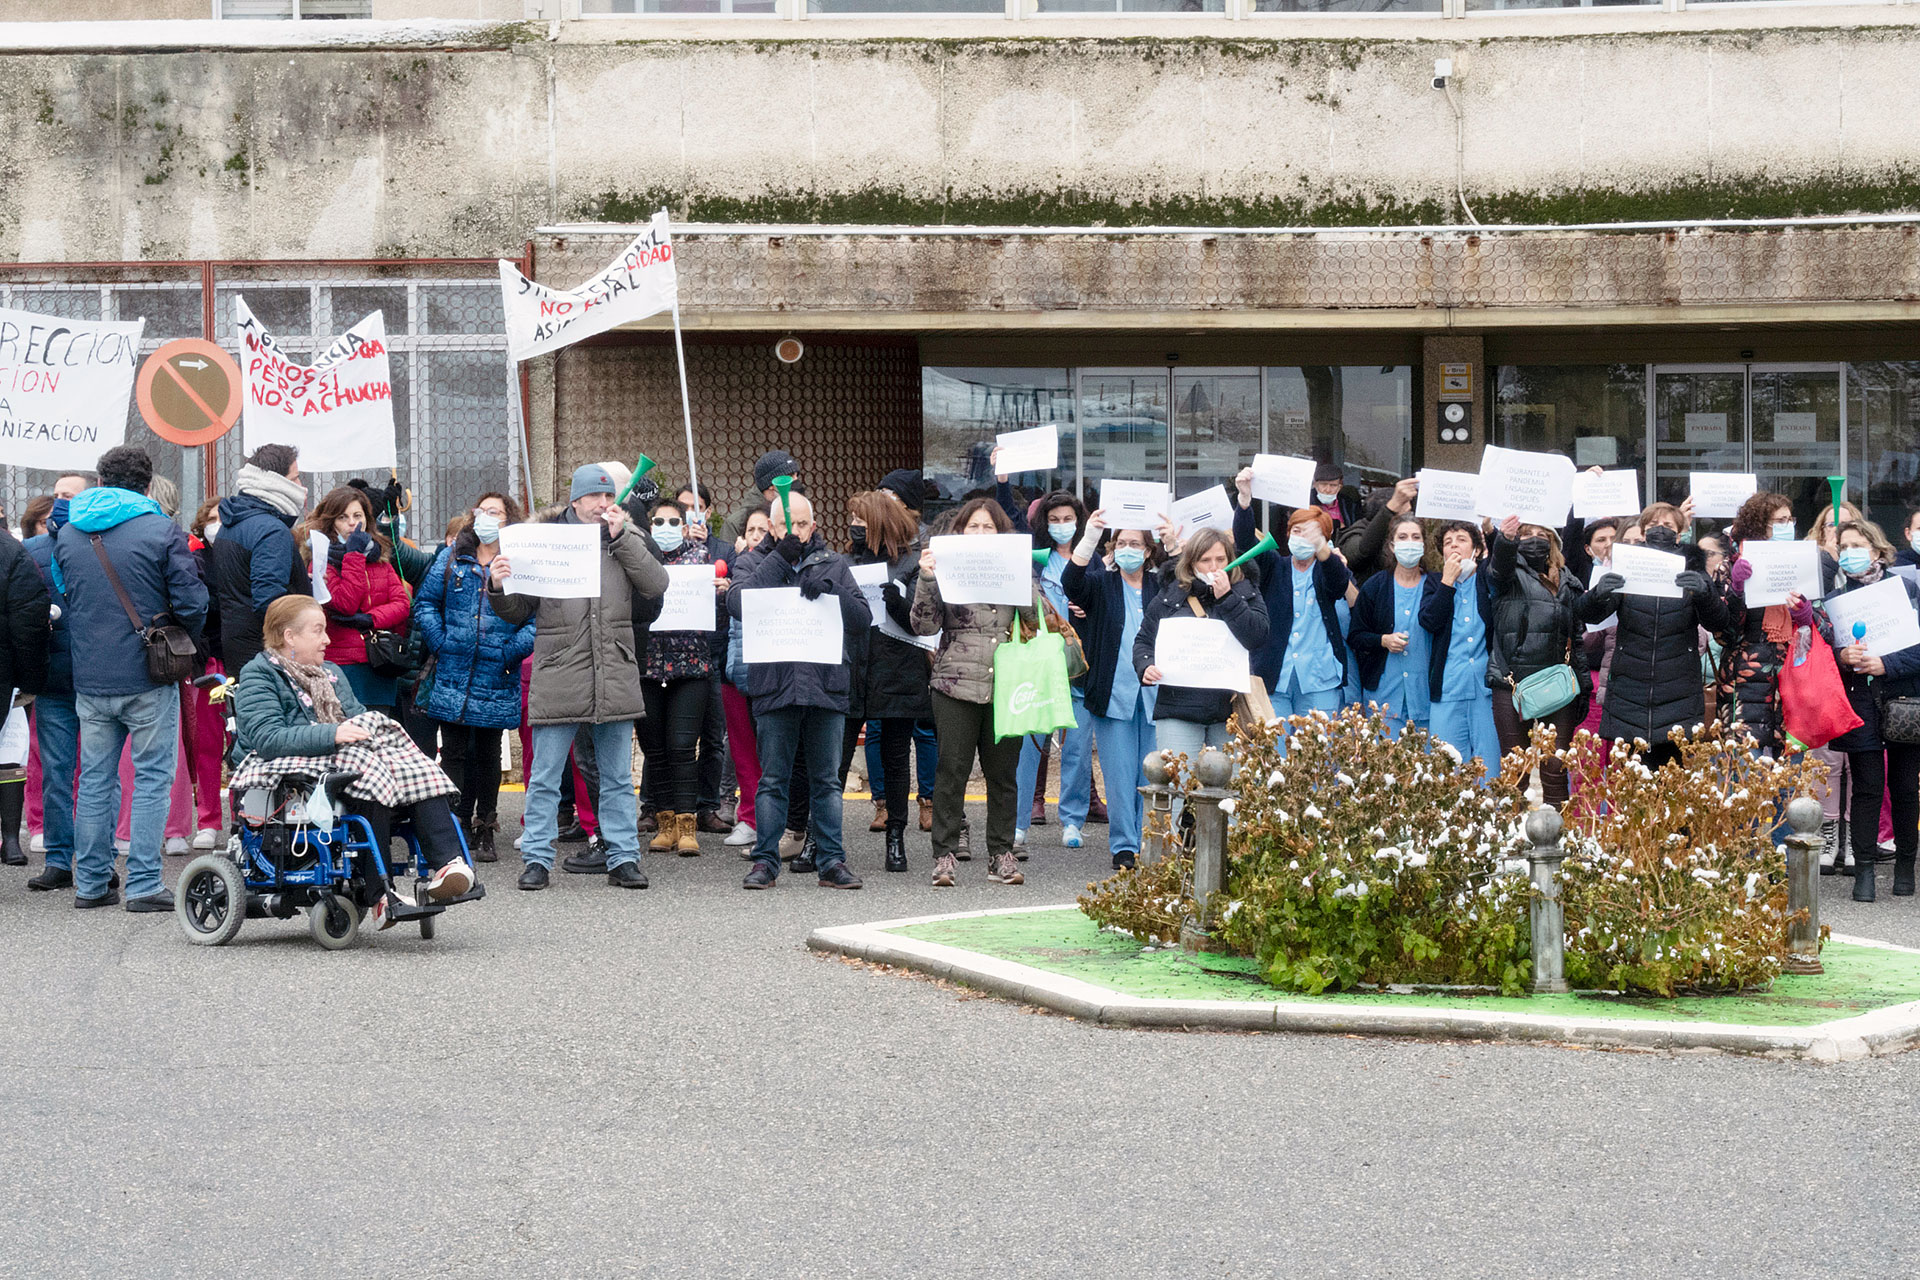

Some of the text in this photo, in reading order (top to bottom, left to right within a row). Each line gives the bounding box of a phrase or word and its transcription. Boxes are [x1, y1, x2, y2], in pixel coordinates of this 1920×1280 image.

[540, 300, 573, 318] NO
[0, 362, 61, 394] ION
[249, 356, 308, 399] PERO
[251, 380, 392, 418] NOS ACHUCHA
[1509, 477, 1545, 486] PANDEMIA
[1504, 485, 1547, 496] ENSALZADOS
[980, 573, 1016, 582] RESIDENTES
[805, 619, 822, 627] CON
